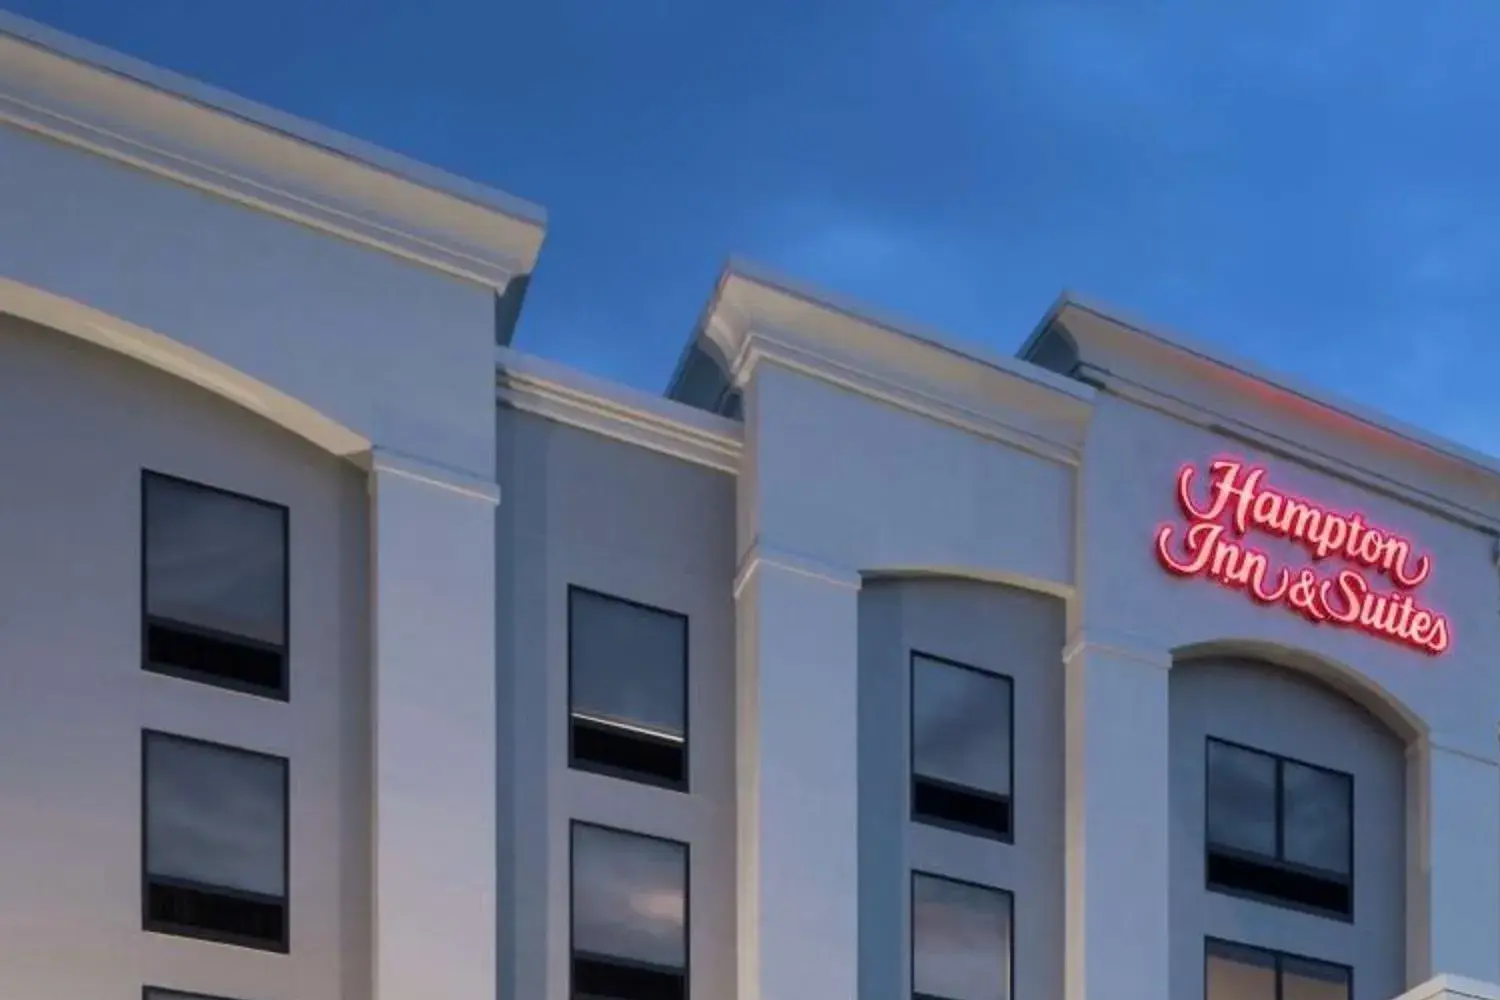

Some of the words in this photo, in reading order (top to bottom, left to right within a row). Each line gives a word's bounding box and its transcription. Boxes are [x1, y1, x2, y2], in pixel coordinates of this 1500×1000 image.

[1178, 460, 1430, 586] Hampton
[1157, 523, 1289, 602] Inn
[1288, 569, 1325, 619] &
[1320, 569, 1450, 653] Suites
